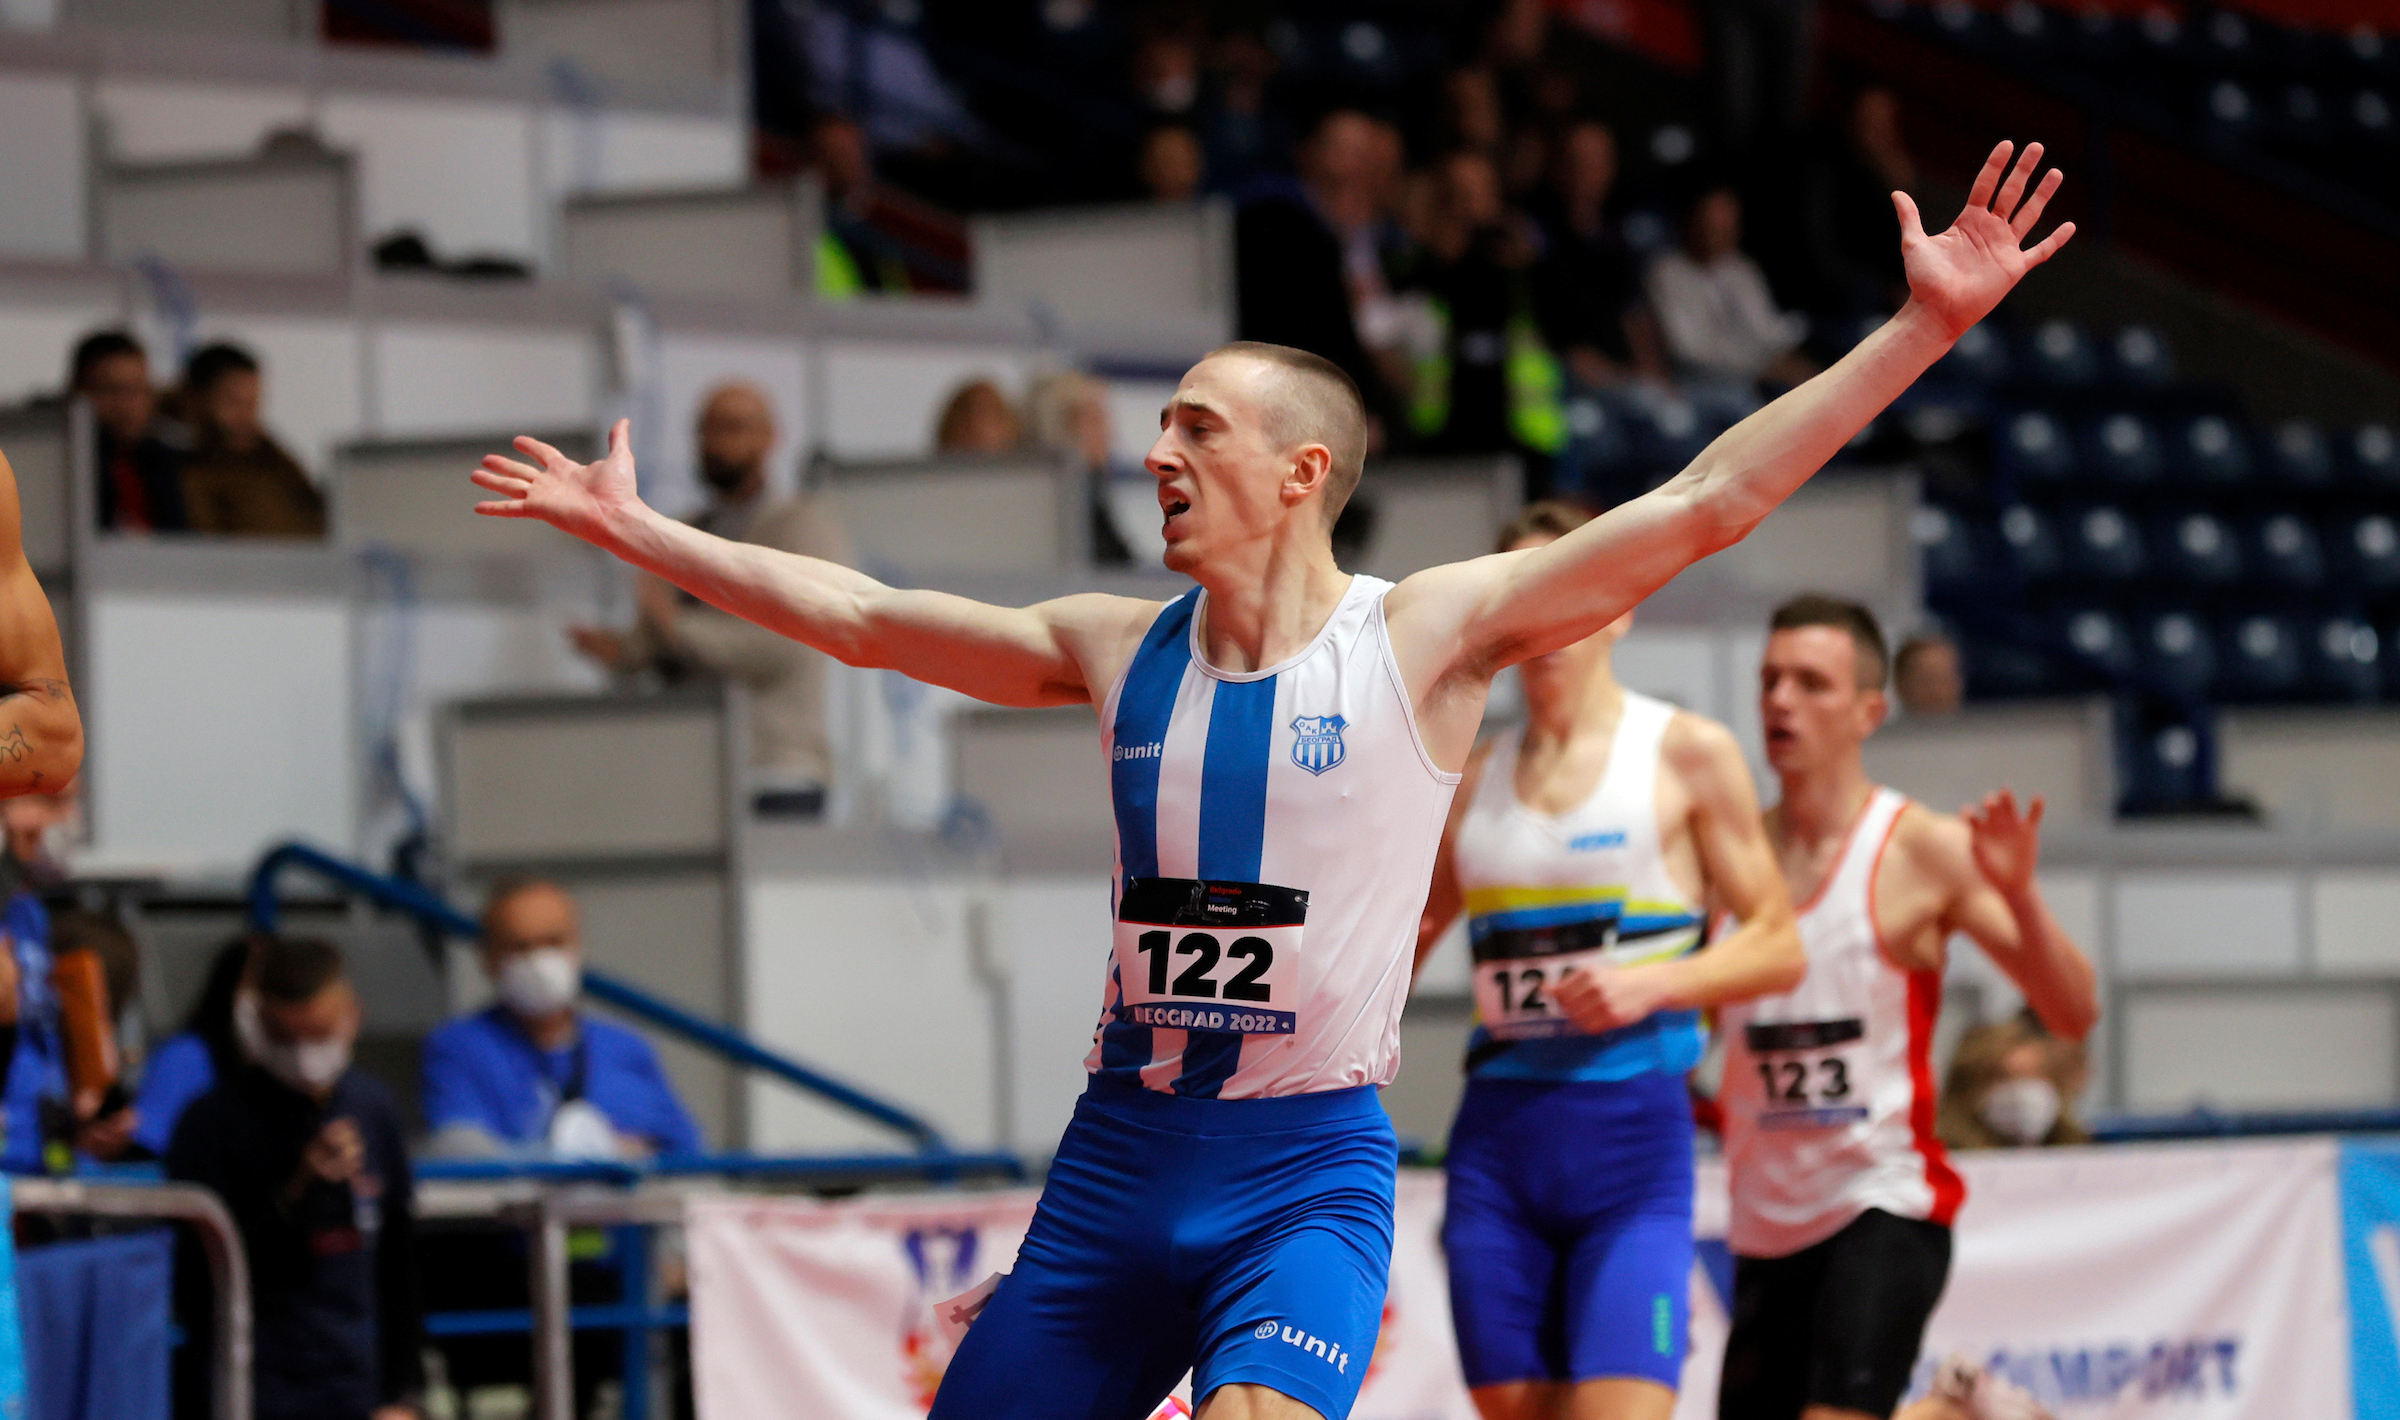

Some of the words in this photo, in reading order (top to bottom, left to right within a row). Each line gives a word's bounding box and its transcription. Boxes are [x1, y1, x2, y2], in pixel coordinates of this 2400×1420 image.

[1124, 741, 1162, 760] unit
[1207, 903, 1238, 916] Meeting
[1138, 930, 1274, 1003] 122
[1493, 964, 1578, 1014] 12
[1134, 1006, 1225, 1029] BEOGRAD
[1229, 1013, 1277, 1033] 2022
[1758, 1057, 1850, 1101] 123
[1281, 1325, 1349, 1375] unit
